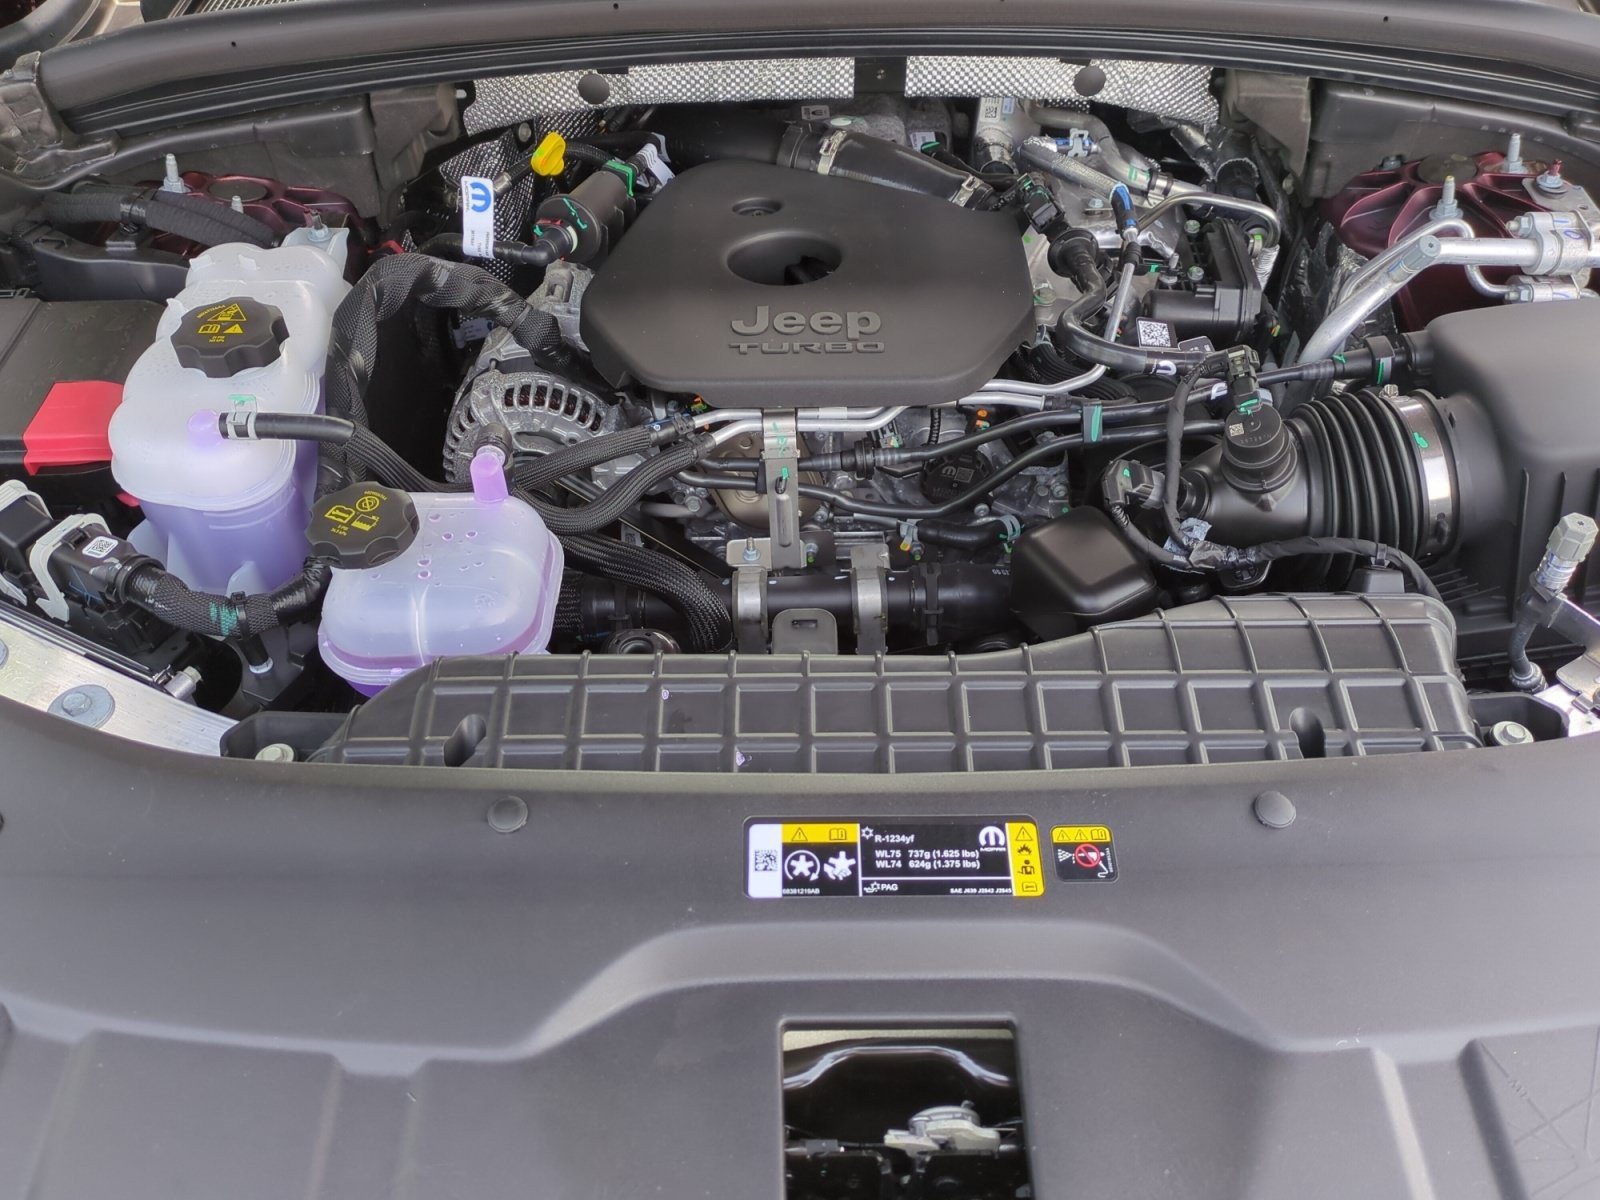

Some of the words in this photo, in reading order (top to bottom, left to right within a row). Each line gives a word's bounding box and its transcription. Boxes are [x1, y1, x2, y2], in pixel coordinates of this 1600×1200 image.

[731, 305, 881, 341] Jeep
[728, 341, 885, 355] TURBO
[874, 834, 915, 844] R-1234yf
[875, 850, 901, 858] WL75
[908, 850, 930, 859] 737g
[932, 850, 960, 859] (1.625
[962, 850, 979, 859] lbs)
[876, 860, 902, 868] WL74
[909, 860, 931, 870] 624g
[933, 860, 961, 869] (1.375
[963, 860, 980, 869] lbs)
[881, 884, 898, 892] PAG
